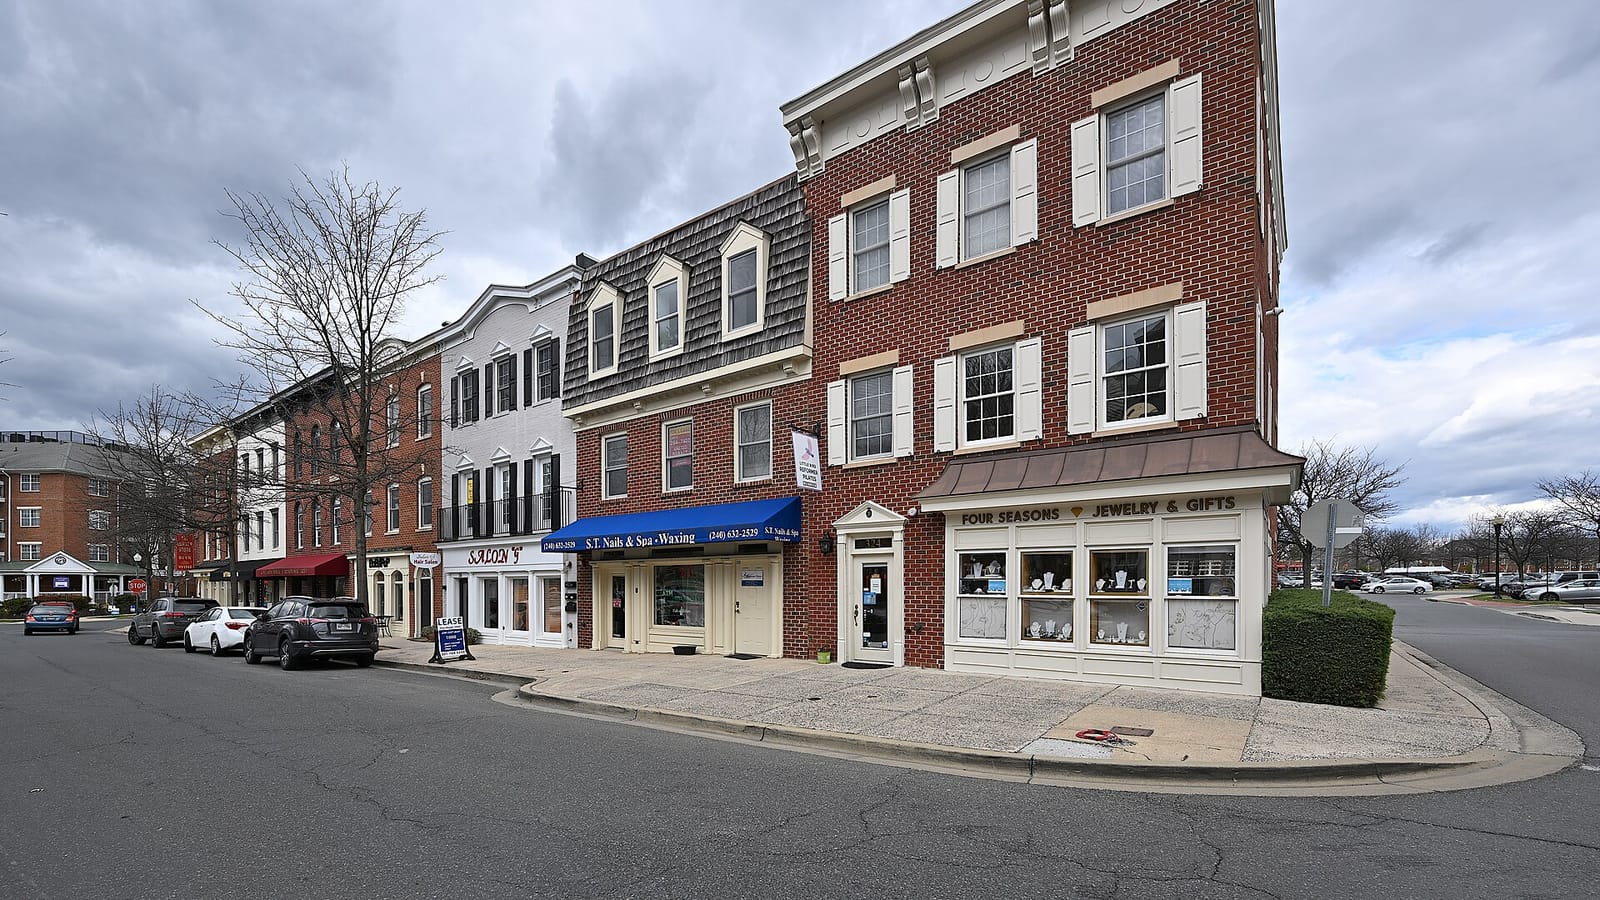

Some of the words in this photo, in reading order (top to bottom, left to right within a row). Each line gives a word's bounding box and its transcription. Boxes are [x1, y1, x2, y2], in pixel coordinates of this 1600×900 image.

[962, 512, 993, 526] FOUR
[998, 508, 1060, 524] SEASONS
[1092, 500, 1160, 518] JEWELRY
[1166, 500, 1179, 513] &
[1186, 496, 1236, 512] GIFTS
[709, 530, 726, 541] (240)
[727, 528, 759, 538] 632-2529
[585, 538, 601, 550] S.T.
[602, 537, 624, 549] Nails
[625, 536, 634, 547] &
[636, 535, 653, 548] Spa
[468, 548, 509, 565] SALON
[129, 581, 147, 590] STOP
[437, 617, 463, 626] LEASE
